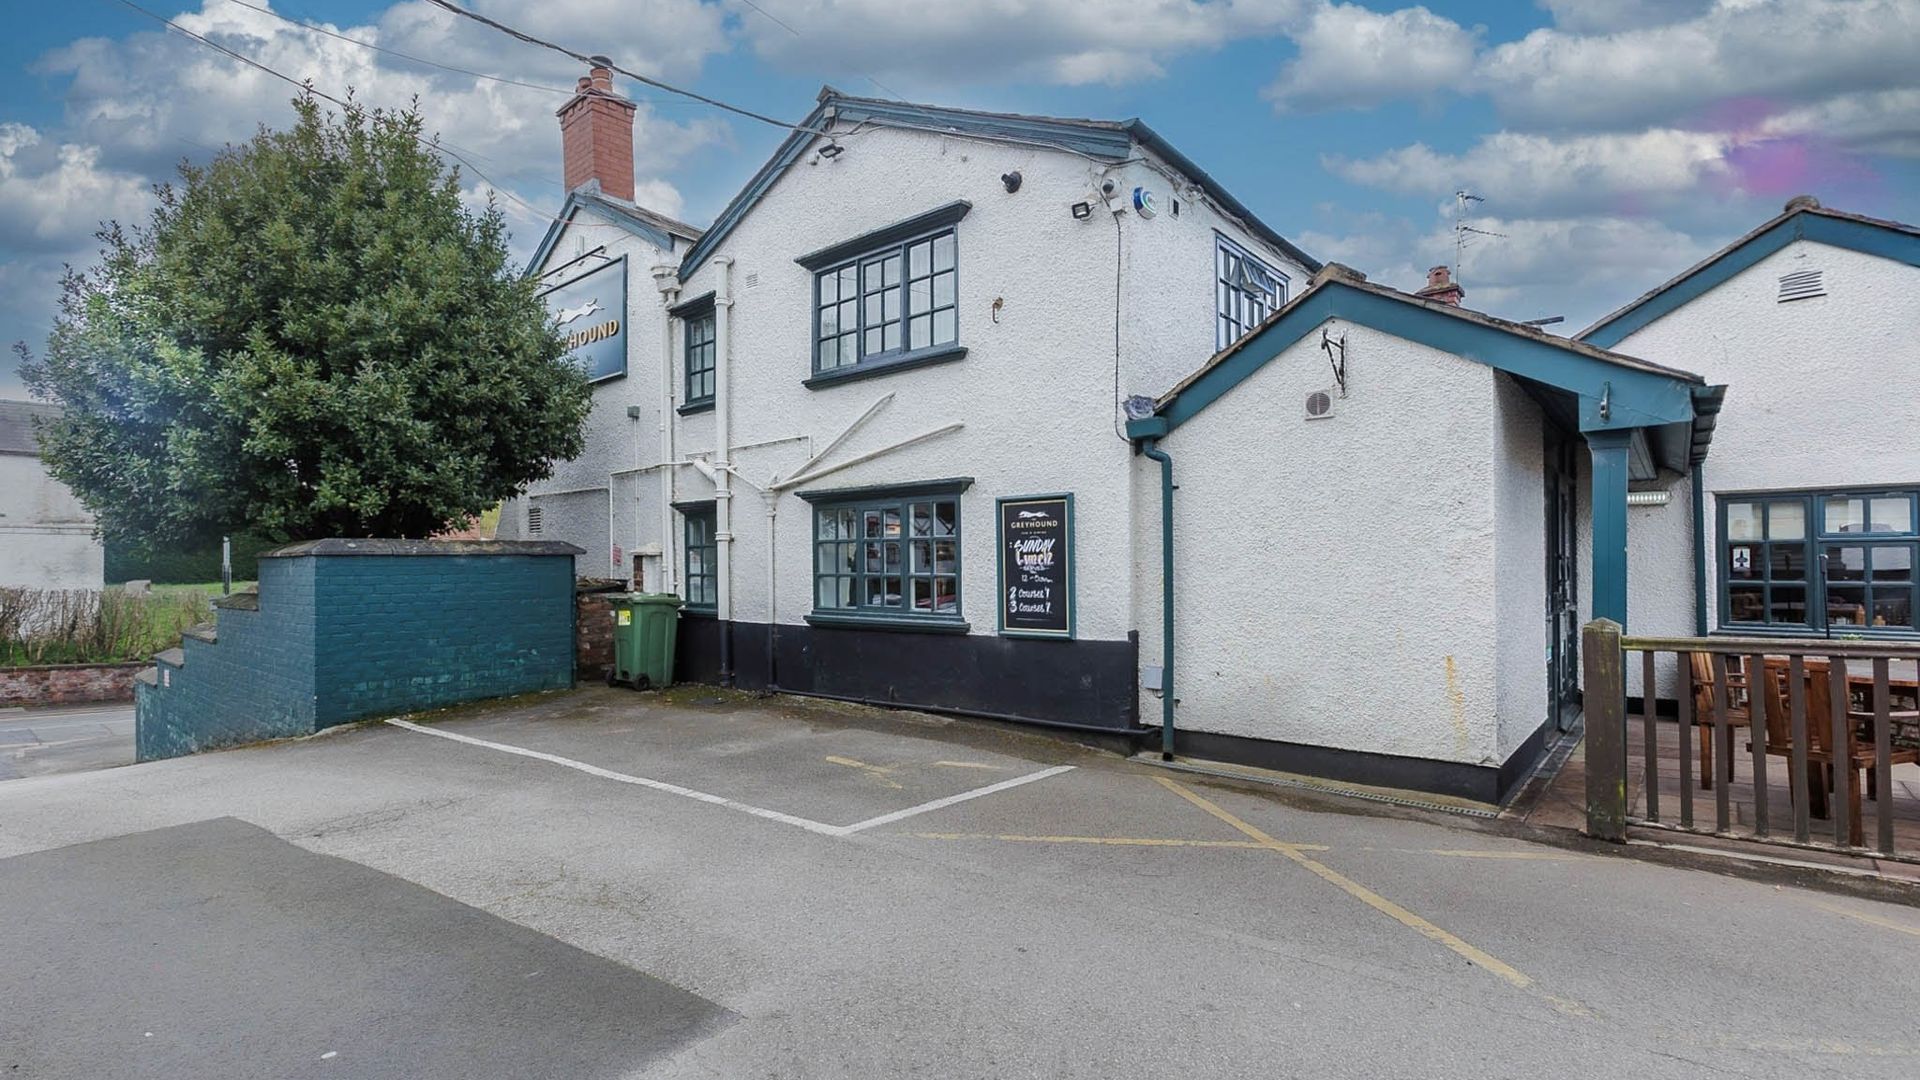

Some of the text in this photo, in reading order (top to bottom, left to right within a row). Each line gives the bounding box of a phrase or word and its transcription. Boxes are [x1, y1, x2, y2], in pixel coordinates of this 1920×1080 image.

[1011, 520, 1058, 529] GREYHOUND
[1014, 538, 1056, 553] SUNDAY
[1009, 586, 1017, 600] 2
[1009, 600, 1018, 613] 3
